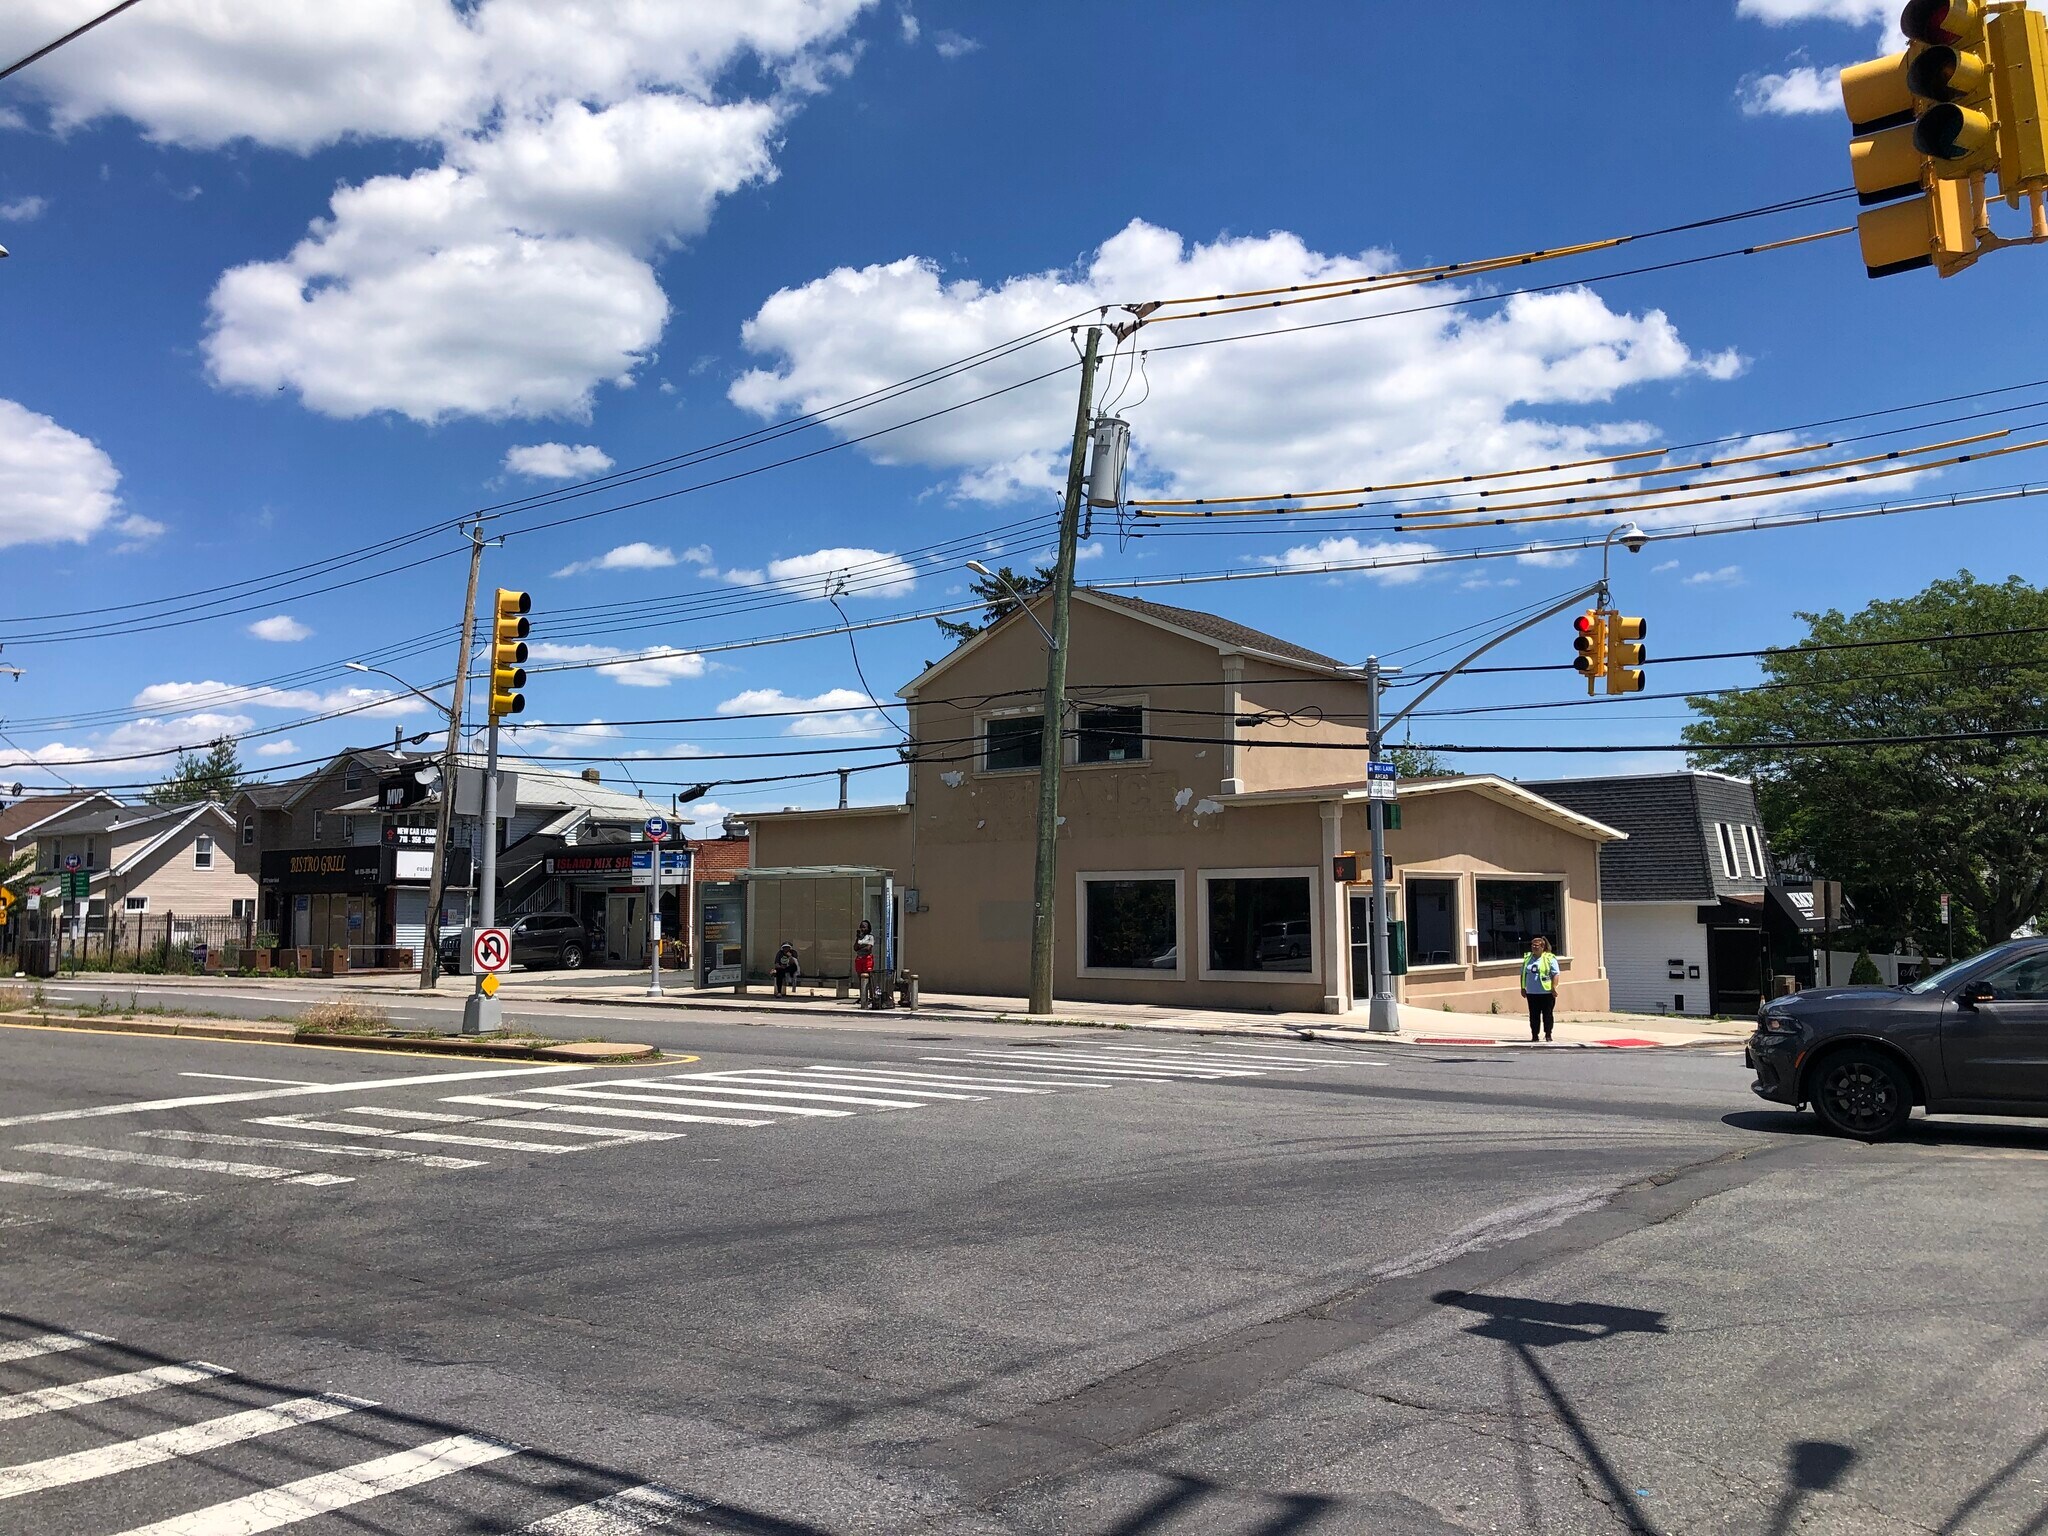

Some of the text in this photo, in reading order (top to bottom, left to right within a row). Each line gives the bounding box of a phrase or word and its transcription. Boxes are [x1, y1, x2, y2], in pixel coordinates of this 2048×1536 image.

[387, 788, 404, 805] MVP
[397, 827, 437, 836] NEW CAR LEASIN
[290, 855, 346, 875] BISTRO GRILL
[557, 858, 593, 869] ISLAND
[593, 857, 613, 869] MIX
